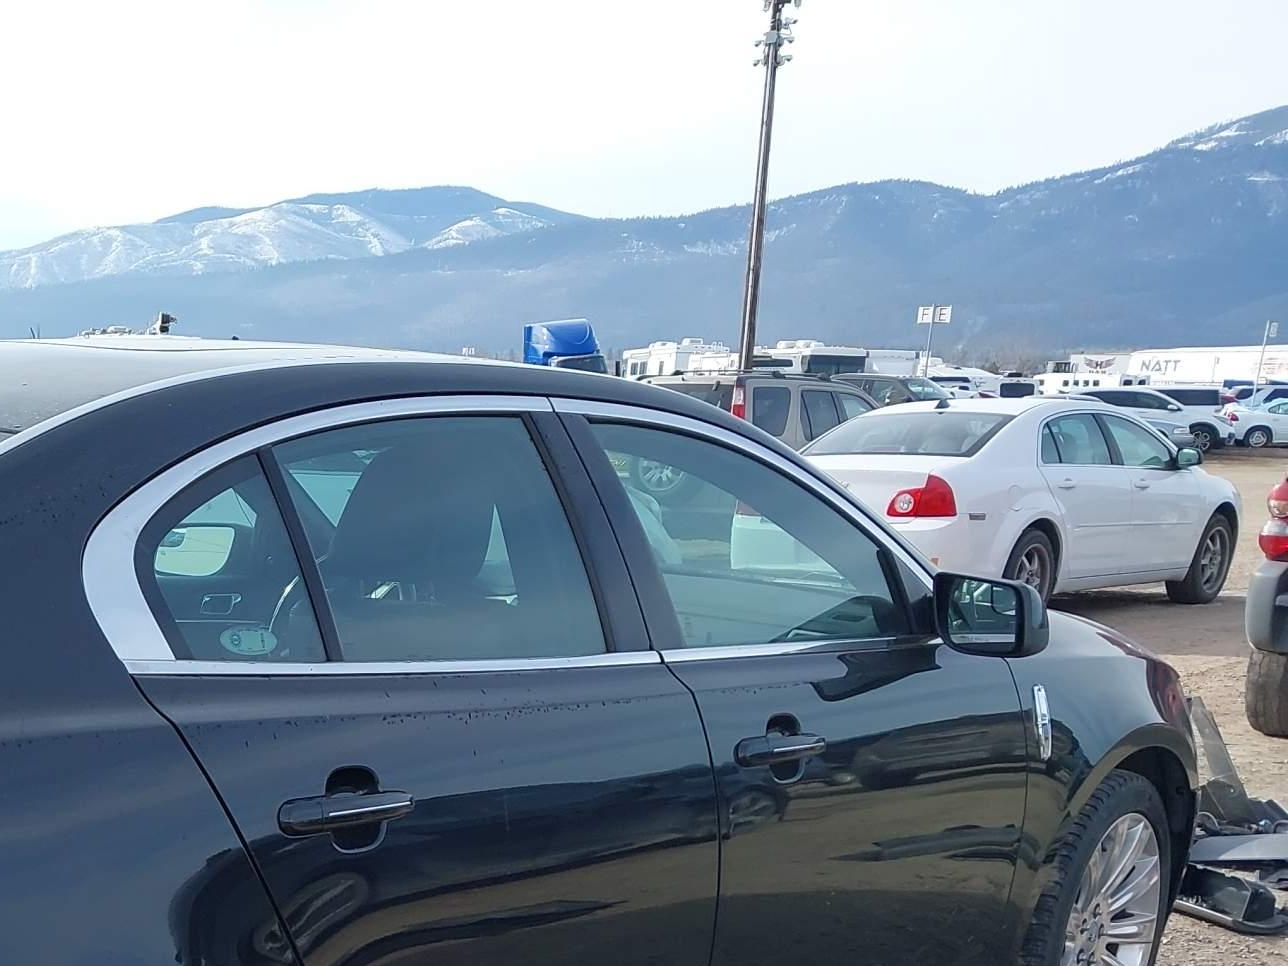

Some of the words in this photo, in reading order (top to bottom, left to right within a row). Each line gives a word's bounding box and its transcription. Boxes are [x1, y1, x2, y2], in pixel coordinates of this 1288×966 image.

[921, 307, 930, 321] F
[938, 307, 947, 321] E
[1140, 359, 1181, 373] NATT
